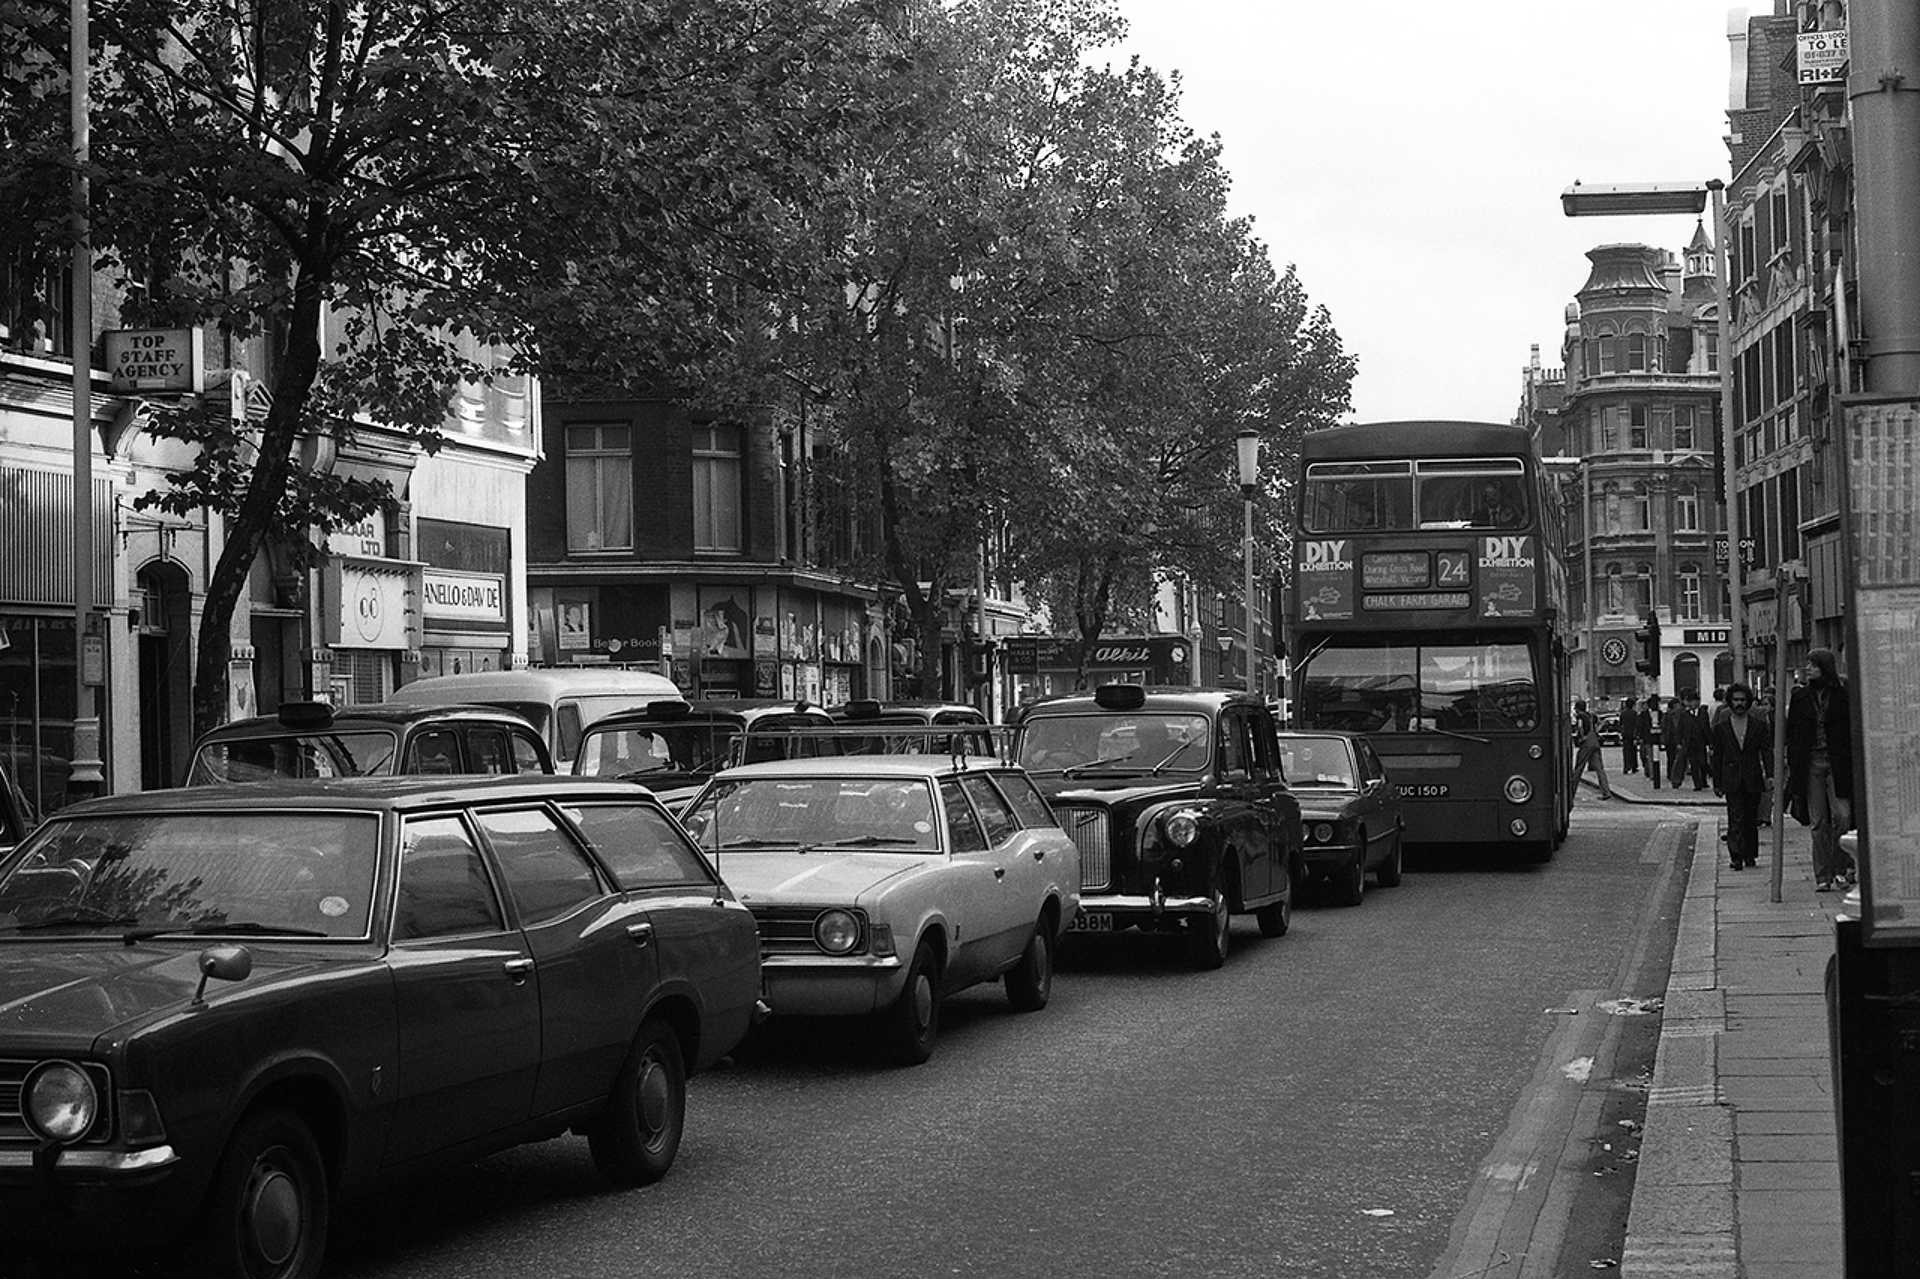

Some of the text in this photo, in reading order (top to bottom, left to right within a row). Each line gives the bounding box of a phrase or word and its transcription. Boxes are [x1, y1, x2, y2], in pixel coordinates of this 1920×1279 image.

[1808, 38, 1849, 50] TO LE
[130, 335, 165, 349] TOP
[120, 349, 176, 364] STAFF
[112, 363, 184, 378] AGENCY
[361, 540, 381, 556] LTD
[1306, 540, 1346, 563] DIY
[1486, 536, 1529, 559] DIY
[1299, 560, 1353, 572] EXHIBITION
[1439, 558, 1468, 581] 24
[1479, 557, 1535, 568] EXHIBITION
[423, 582, 460, 606] ANELLO
[467, 585, 499, 609] DAVDE
[1366, 594, 1396, 609] CHALK
[1401, 594, 1427, 607] FARM
